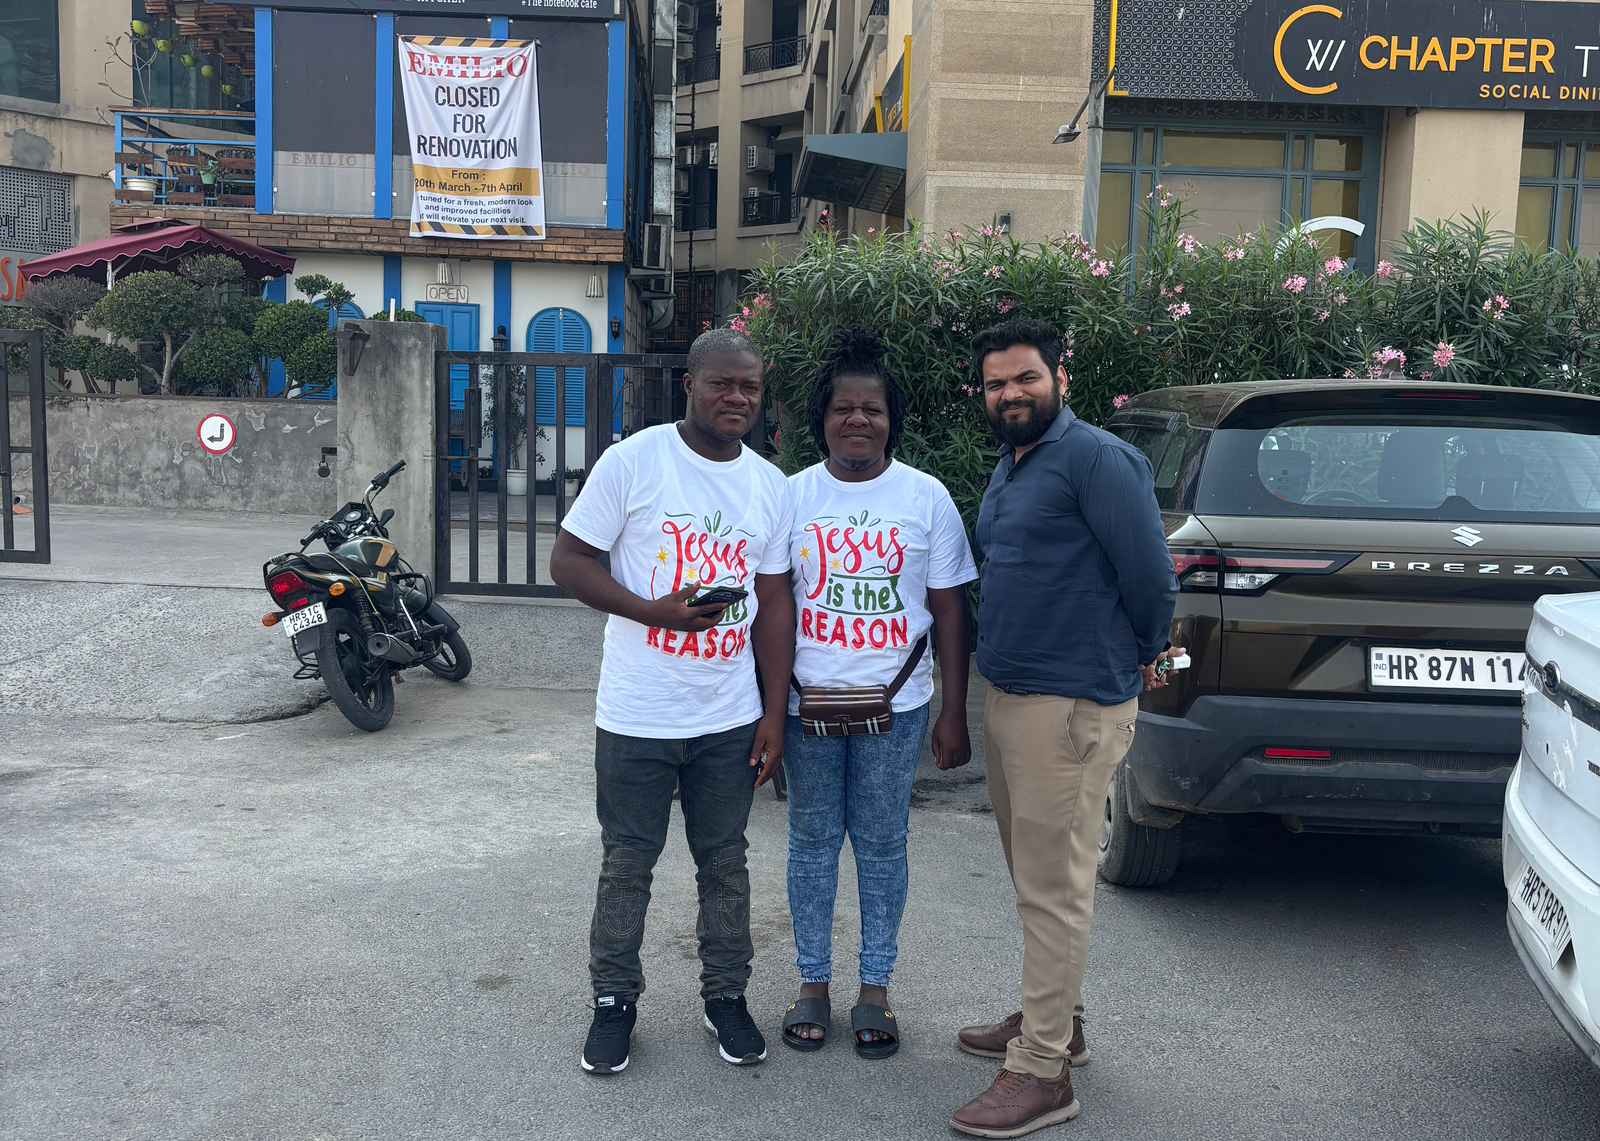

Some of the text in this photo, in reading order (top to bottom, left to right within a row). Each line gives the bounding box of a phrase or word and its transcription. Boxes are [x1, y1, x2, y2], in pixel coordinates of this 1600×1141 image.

[407, 51, 528, 79] EMILIO
[1359, 35, 1599, 78] CHAPTER T
[434, 85, 500, 108] CLOSED
[1479, 84, 1551, 99] SOCIAL
[453, 113, 486, 134] FOR
[417, 134, 518, 159] RENOVATION
[291, 153, 358, 167] EMILIO
[451, 170, 479, 180] From
[415, 178, 435, 189] 20th
[438, 181, 471, 192] March
[481, 183, 497, 193] 7th
[499, 182, 522, 193] April
[420, 195, 442, 203] tuned
[463, 199, 486, 207] fresh,
[441, 205, 478, 215] improved
[426, 212, 440, 220] will
[471, 217, 489, 225] your
[490, 216, 507, 224] next
[509, 216, 527, 224] visit.
[429, 286, 466, 300] OPEN
[650, 521, 749, 601] Jesus
[800, 521, 908, 600] Jesus
[1371, 560, 1569, 576] BREZZA
[825, 577, 890, 611] is the
[289, 604, 319, 624] HR51C
[292, 613, 324, 632] C4348
[800, 607, 909, 651] REASON
[1373, 663, 1387, 671] IND
[1388, 654, 1418, 681] HR
[1428, 656, 1475, 682] 87N
